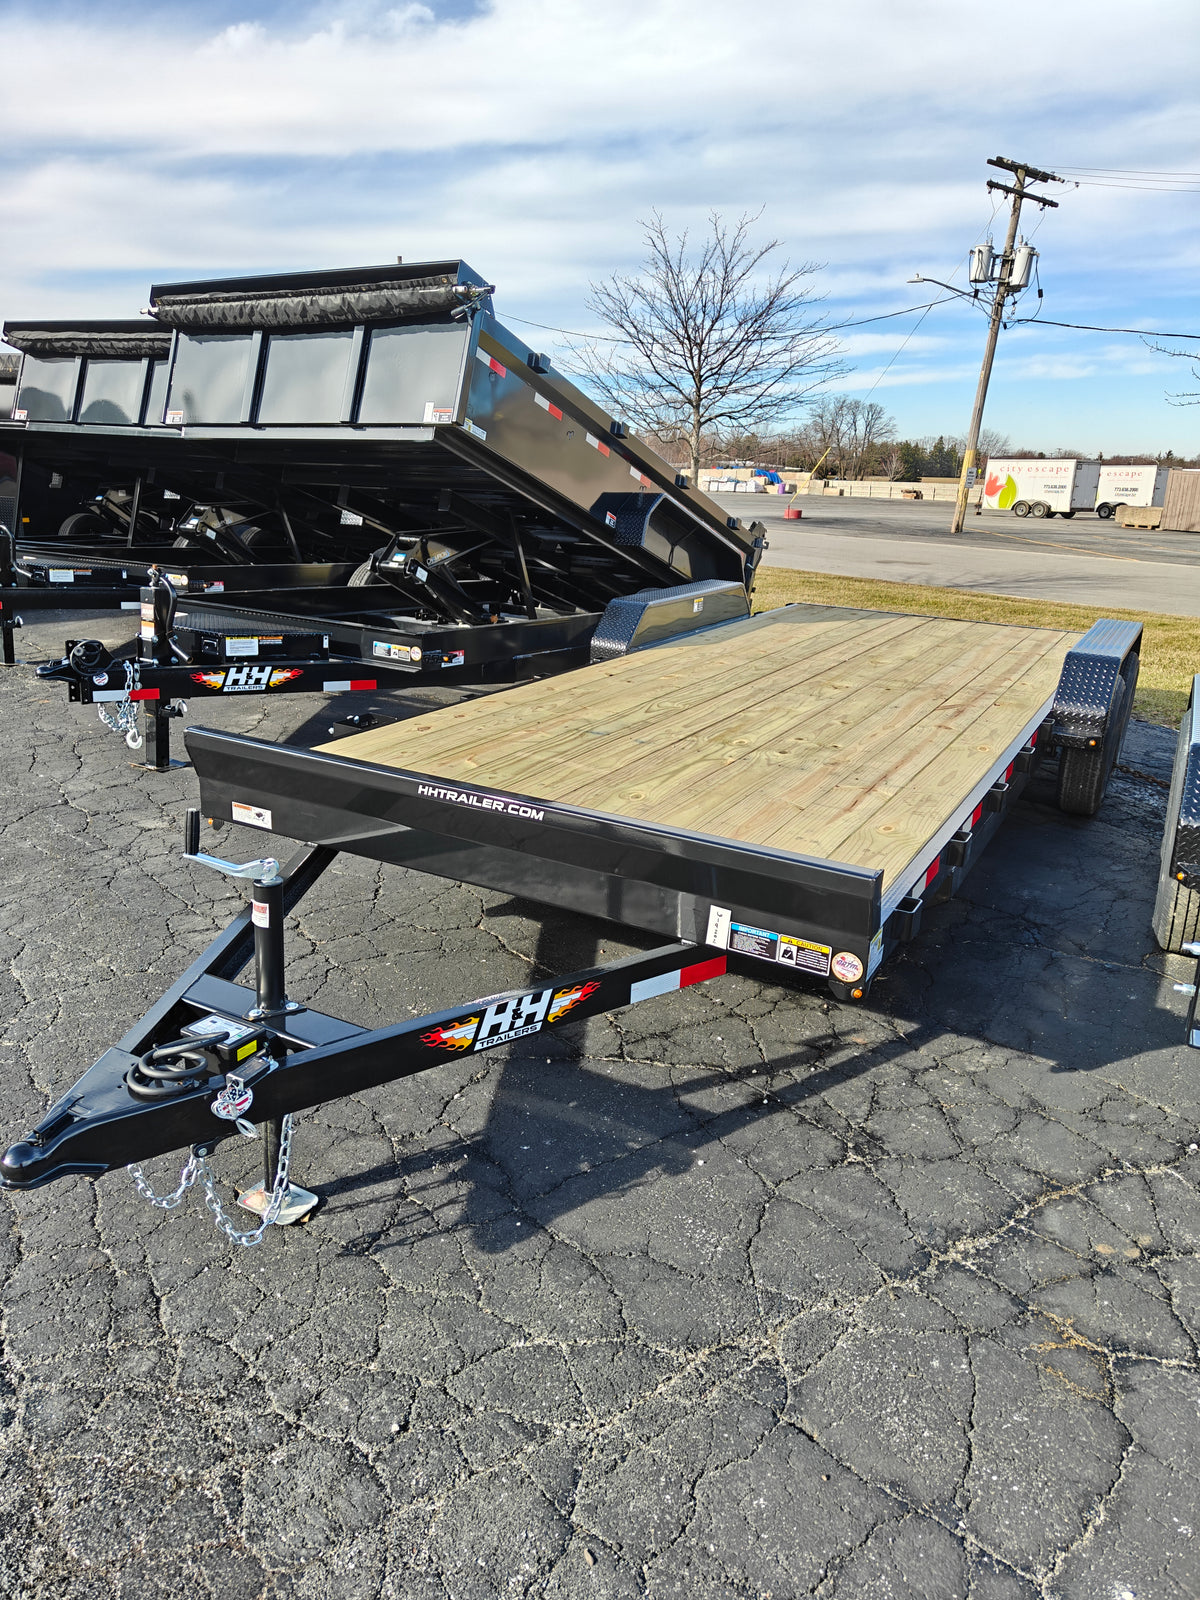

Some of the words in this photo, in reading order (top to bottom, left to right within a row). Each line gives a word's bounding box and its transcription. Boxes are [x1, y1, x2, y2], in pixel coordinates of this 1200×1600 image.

[1000, 464, 1022, 474] city
[1027, 466, 1069, 474] escape
[225, 666, 272, 686] H&H
[418, 785, 545, 820] HHTRAILER.COM
[795, 940, 823, 952] CAUTION
[477, 988, 554, 1041] H&H
[479, 1025, 539, 1048] TRAILERS
